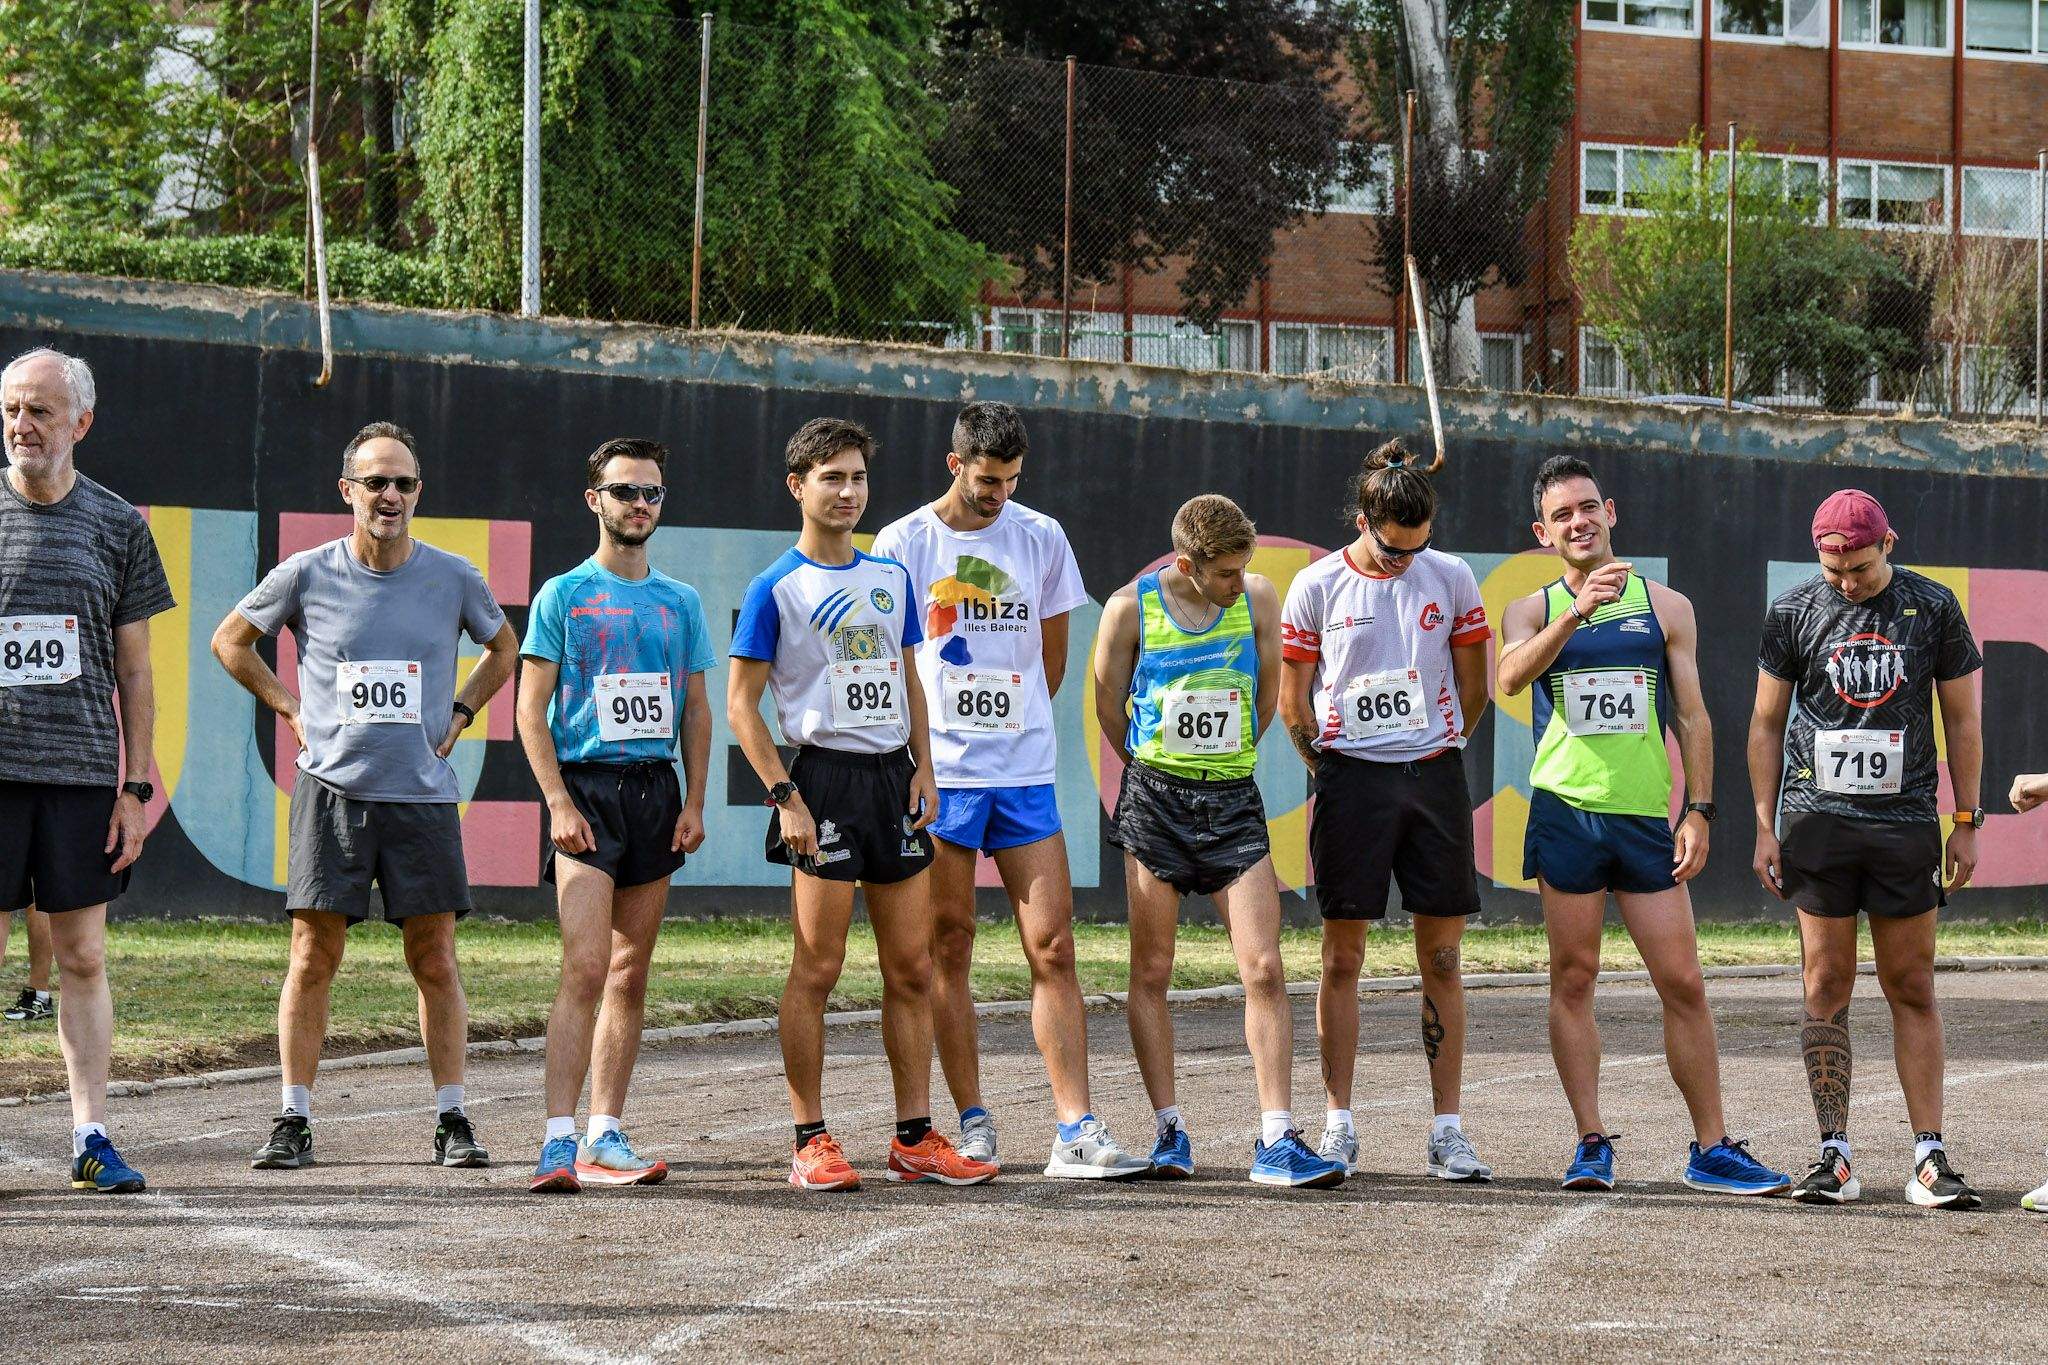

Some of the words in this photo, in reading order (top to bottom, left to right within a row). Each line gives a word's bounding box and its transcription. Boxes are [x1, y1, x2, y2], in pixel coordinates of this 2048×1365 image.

[963, 597, 1029, 620] Ibiza
[964, 623, 987, 632] Illes
[990, 623, 1027, 633] Balears
[4, 639, 65, 670] 849
[1829, 639, 1876, 649] SOSPECHOSOS
[352, 682, 407, 708] 906
[846, 681, 892, 711] 892
[957, 690, 1010, 718] 869
[1356, 690, 1411, 722] 866
[1579, 692, 1635, 721] 764
[1854, 691, 1881, 699] RUNNERS
[612, 695, 663, 724] 905
[1408, 718, 1424, 726] 2023
[1177, 711, 1229, 739] 867
[1830, 751, 1888, 779] 719
